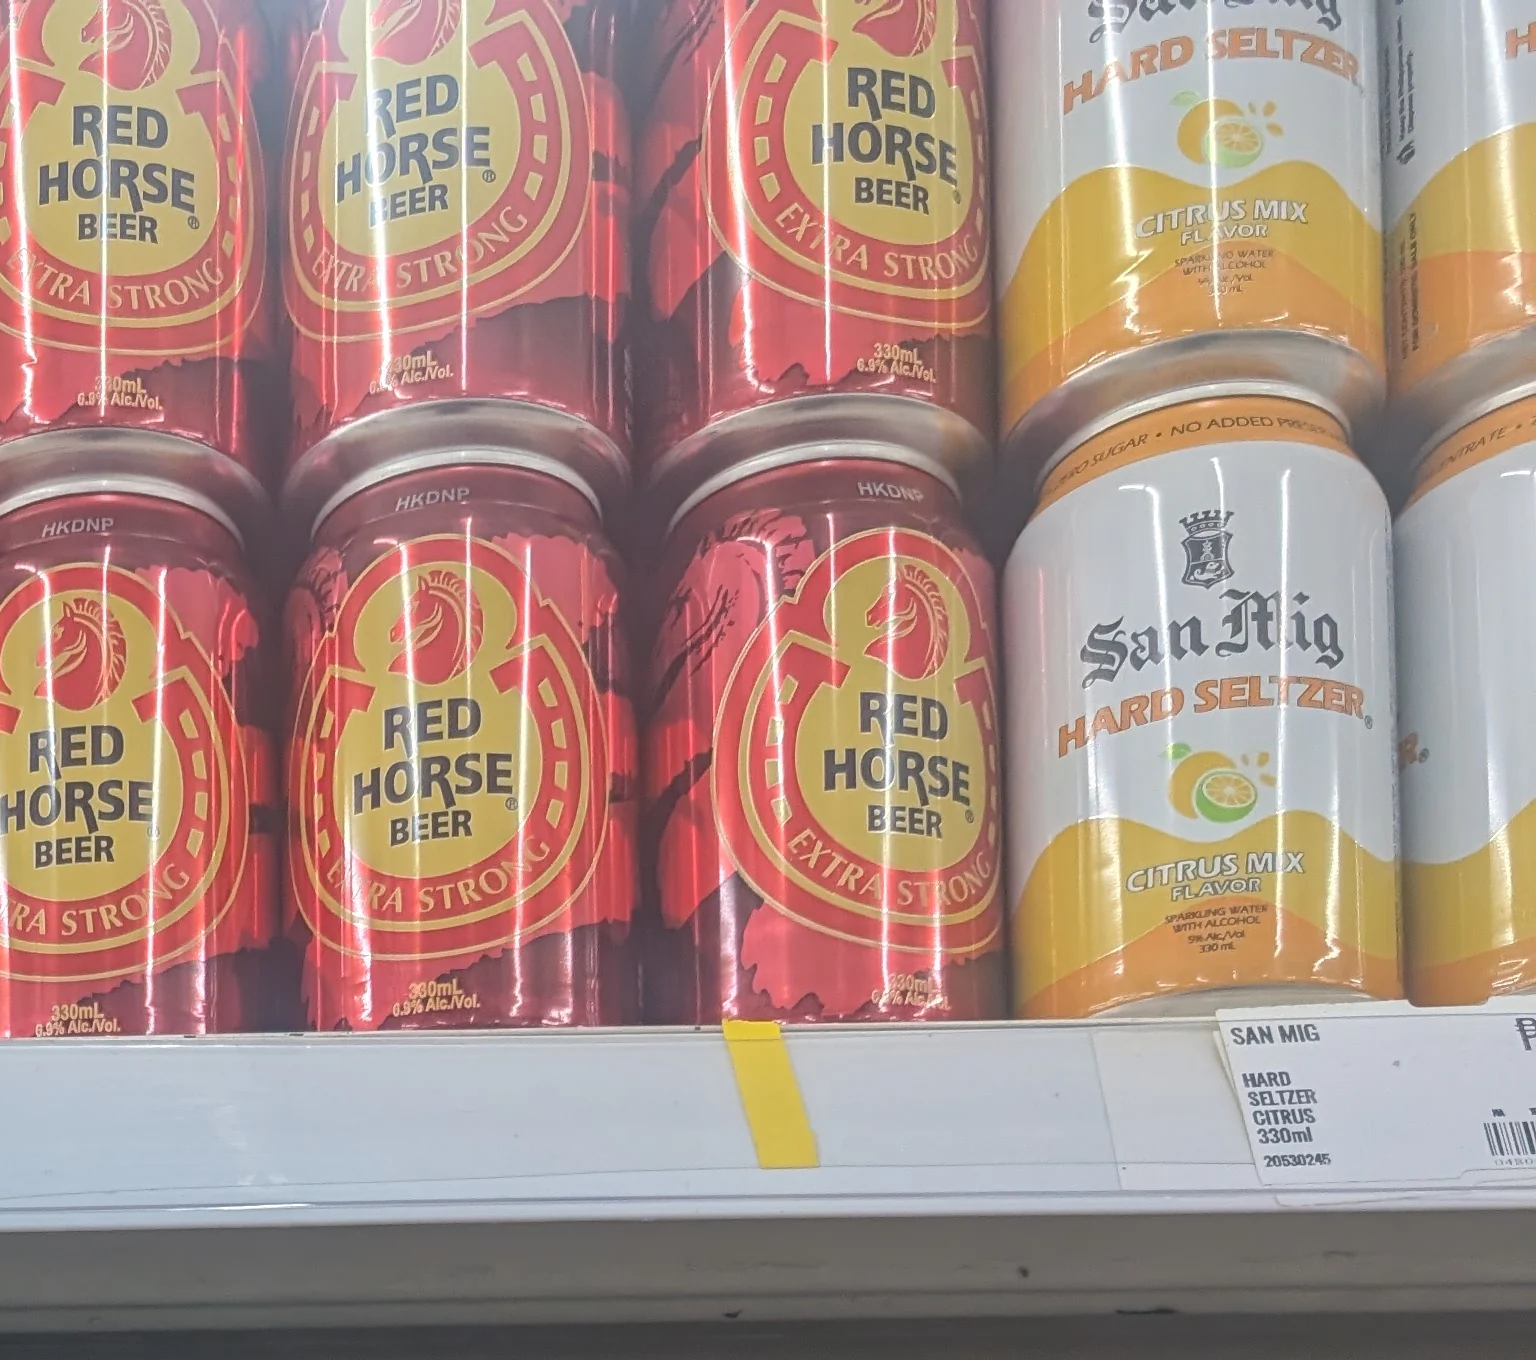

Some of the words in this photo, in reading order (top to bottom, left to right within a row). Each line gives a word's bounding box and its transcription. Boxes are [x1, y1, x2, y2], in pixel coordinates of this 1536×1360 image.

[1063, 36, 1194, 116] HARD
[1204, 27, 1359, 83] SELTZER
[846, 67, 937, 121] RED
[811, 122, 958, 186] HORSE
[853, 177, 930, 216] BEER
[1092, 433, 1149, 467] SUGAR
[1170, 421, 1201, 437] NO
[1206, 416, 1273, 429] ADDED
[1080, 615, 1209, 690] San
[1216, 588, 1345, 671] Mig
[382, 698, 482, 758] RED
[1057, 685, 1185, 758] HARD
[1193, 675, 1365, 717] SELTZER
[352, 752, 514, 815] HORSE
[390, 805, 473, 847] BEER
[1126, 853, 1238, 893] CITRUS
[1246, 852, 1305, 874] MIX
[1171, 877, 1261, 902] FLAVOR
[1205, 916, 1261, 928] ALCOHOL
[1231, 1025, 1274, 1046] SAN
[1278, 1023, 1320, 1043] MIG
[1241, 1072, 1291, 1088] HARD
[1247, 1089, 1317, 1106] SELTZER
[1252, 1109, 1316, 1125] CITRUS
[1257, 1126, 1313, 1144] 330ml
[1263, 1153, 1331, 1168] 20530245
